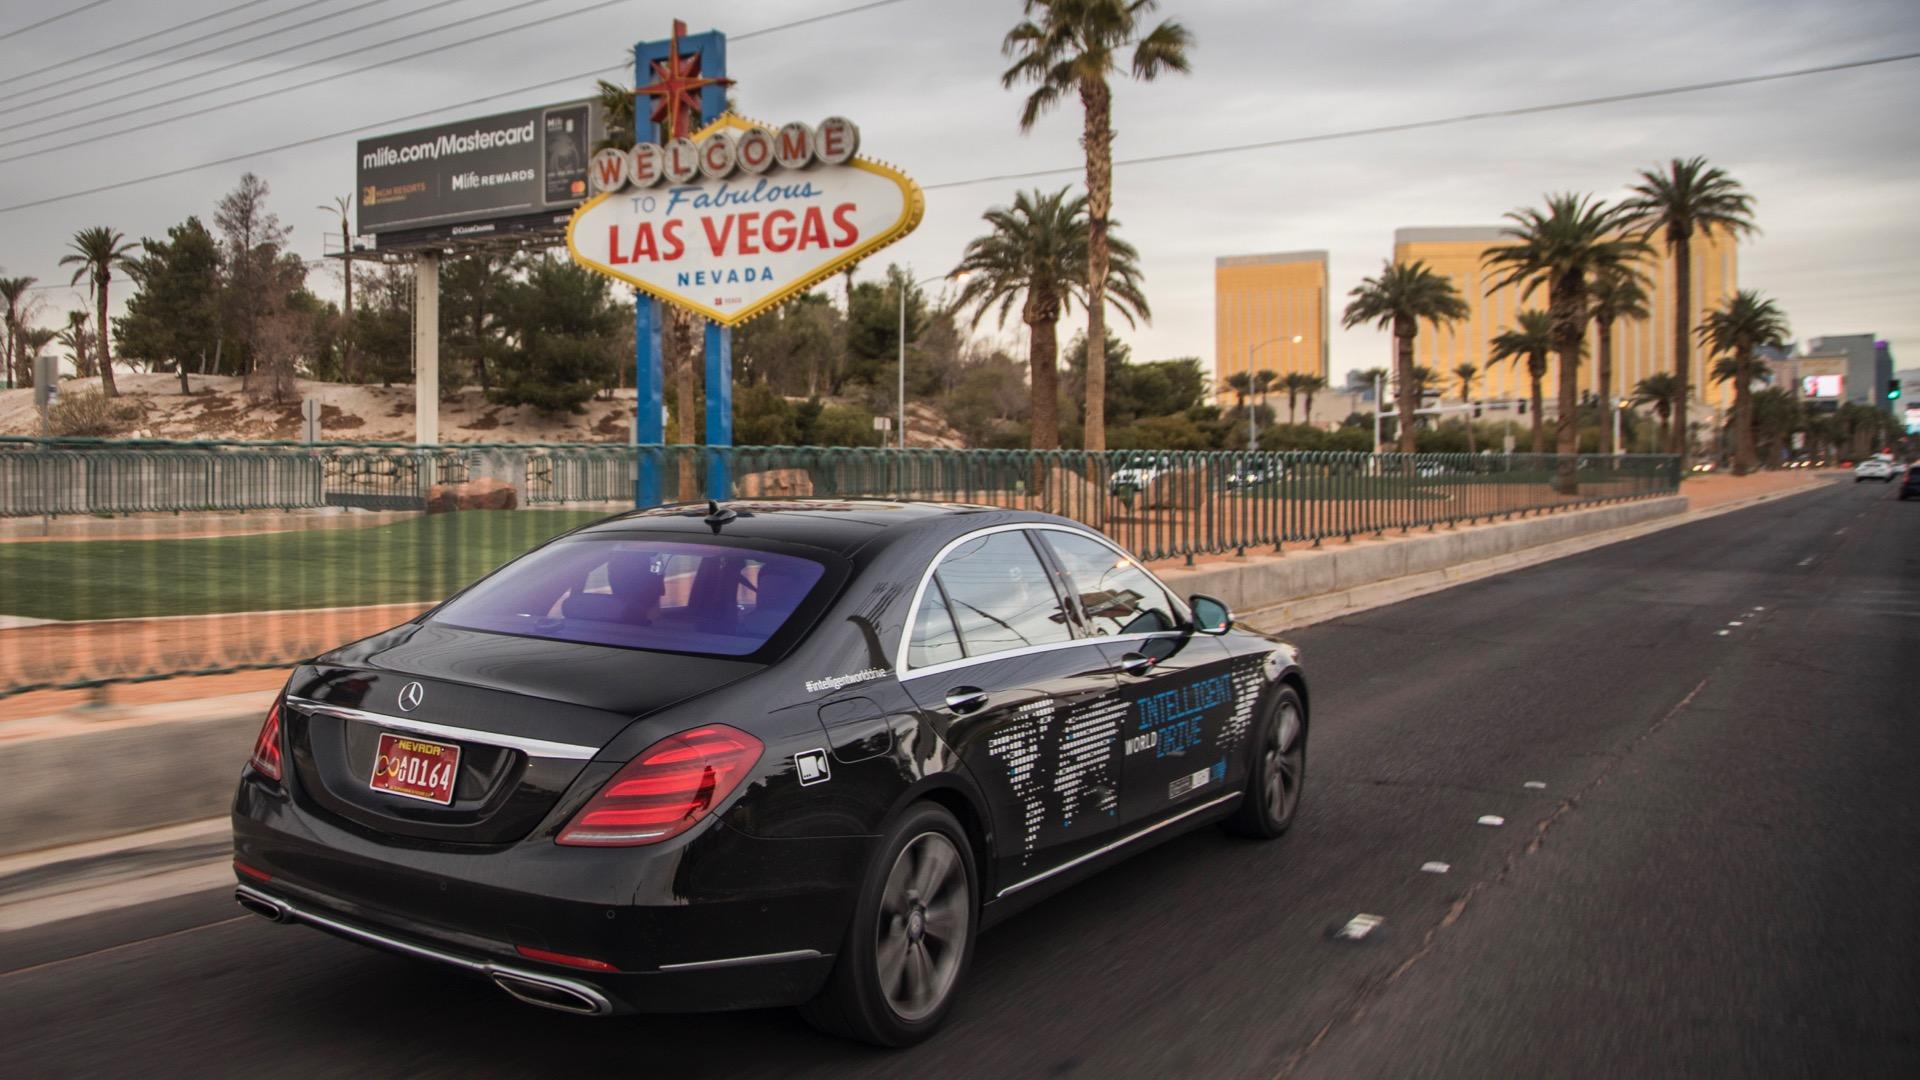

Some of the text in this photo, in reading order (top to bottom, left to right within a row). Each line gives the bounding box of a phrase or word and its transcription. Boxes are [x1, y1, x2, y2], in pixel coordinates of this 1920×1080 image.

[363, 120, 534, 170] mlife.com/Mastercard
[600, 126, 845, 179] WELCOME
[481, 169, 535, 186] REWARDS
[632, 179, 823, 216] TO Fabulous
[609, 203, 860, 265] LAS VEGAS
[678, 266, 774, 287] NEVADA
[398, 739, 442, 756] NEVADA
[1125, 731, 1158, 756] WORLD
